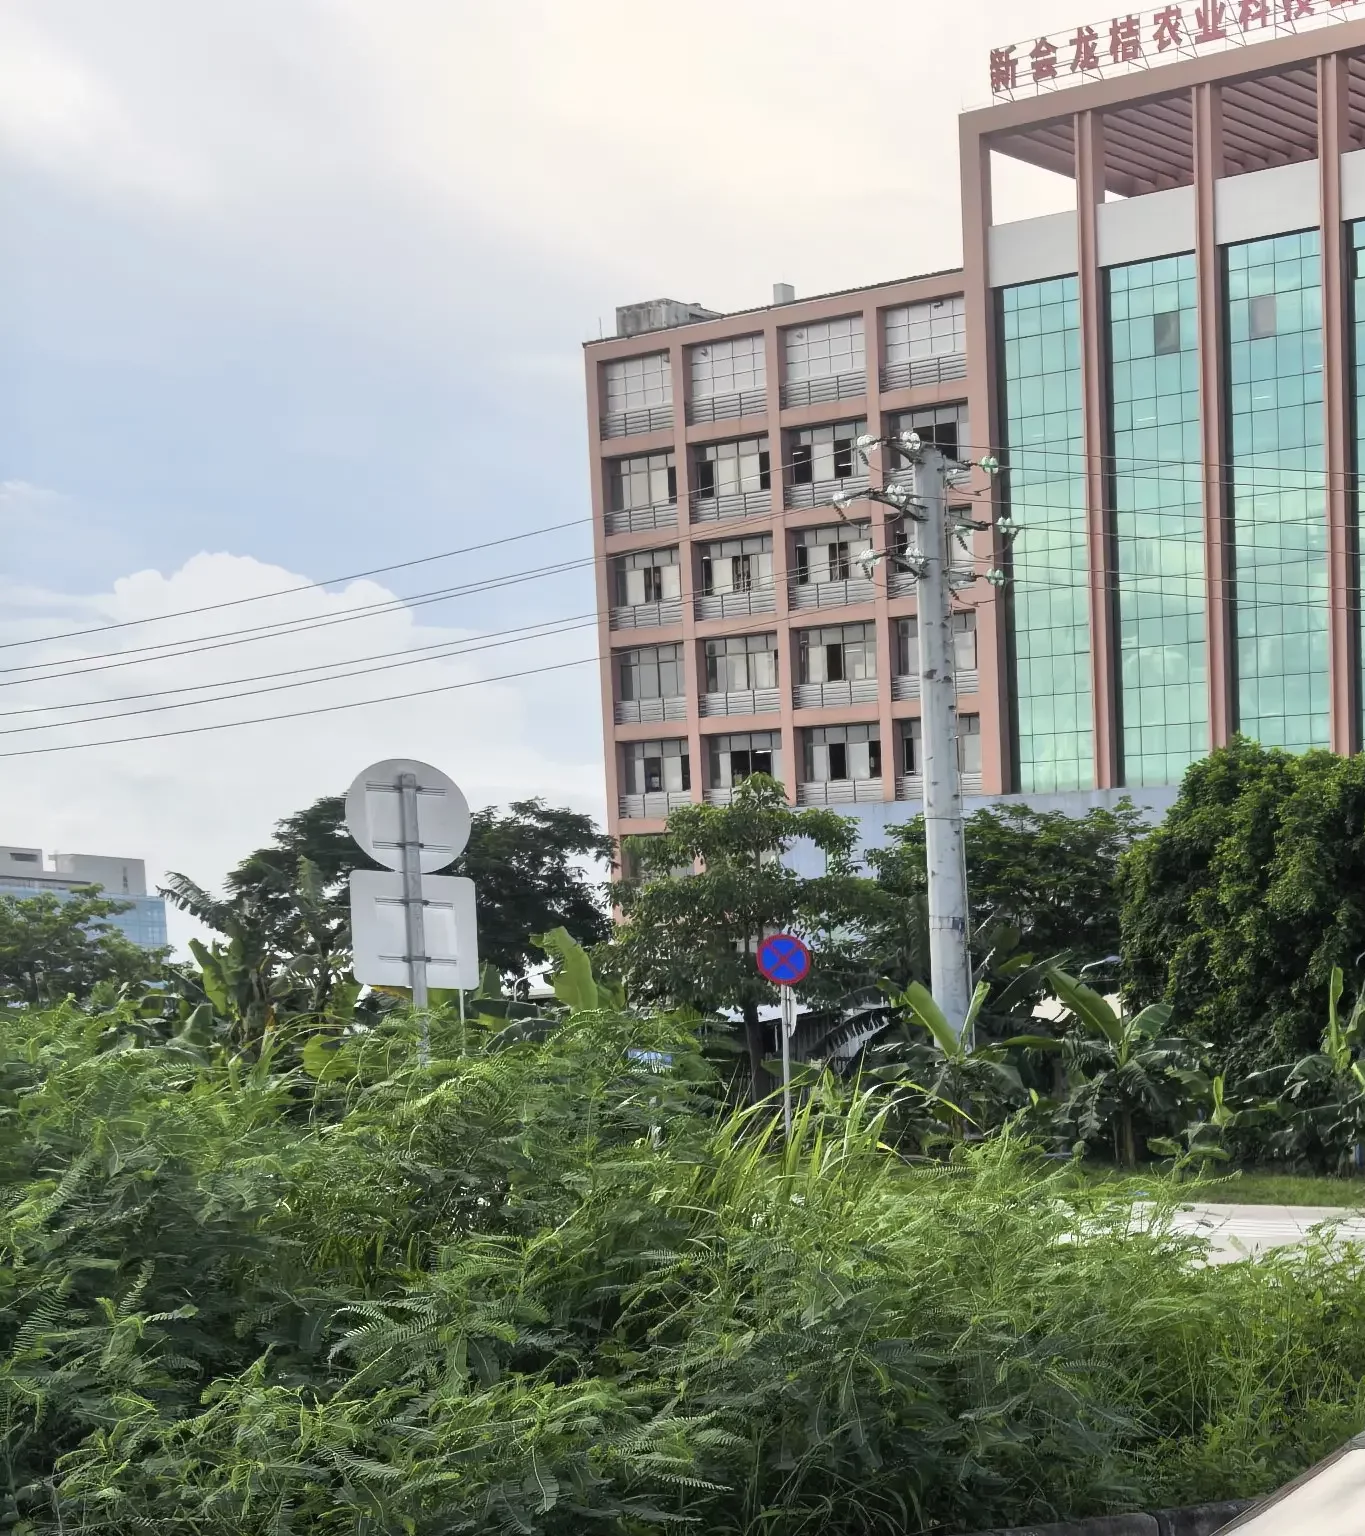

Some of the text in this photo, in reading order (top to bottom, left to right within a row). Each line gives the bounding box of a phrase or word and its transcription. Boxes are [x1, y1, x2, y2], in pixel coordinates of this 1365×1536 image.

[989, 0, 1357, 93] 新会龙桔农业科
